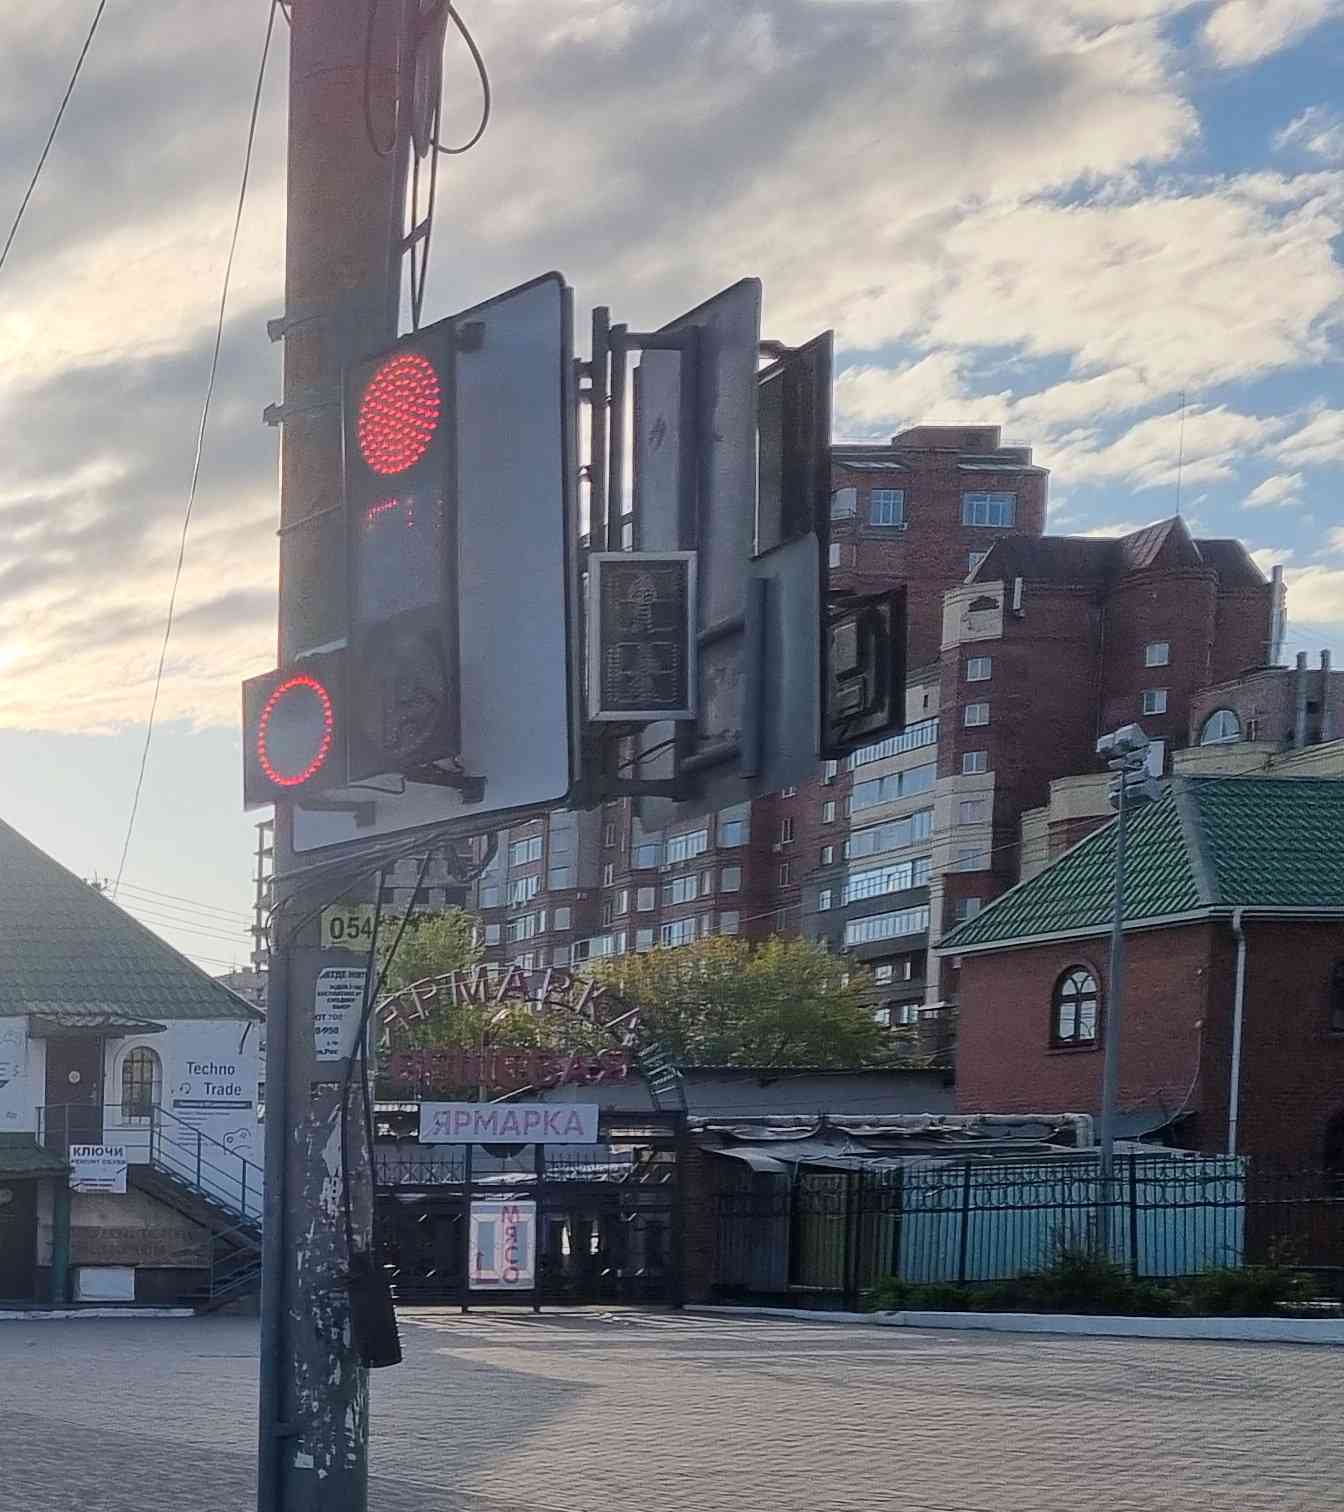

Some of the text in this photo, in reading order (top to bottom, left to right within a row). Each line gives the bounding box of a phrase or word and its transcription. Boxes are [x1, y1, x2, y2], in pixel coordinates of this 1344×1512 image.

[186, 1061, 235, 1076] Techno
[203, 1082, 242, 1096] Trade
[429, 1110, 585, 1136] ЯРМАРКА
[72, 1147, 124, 1158] КЛЮЧИ
